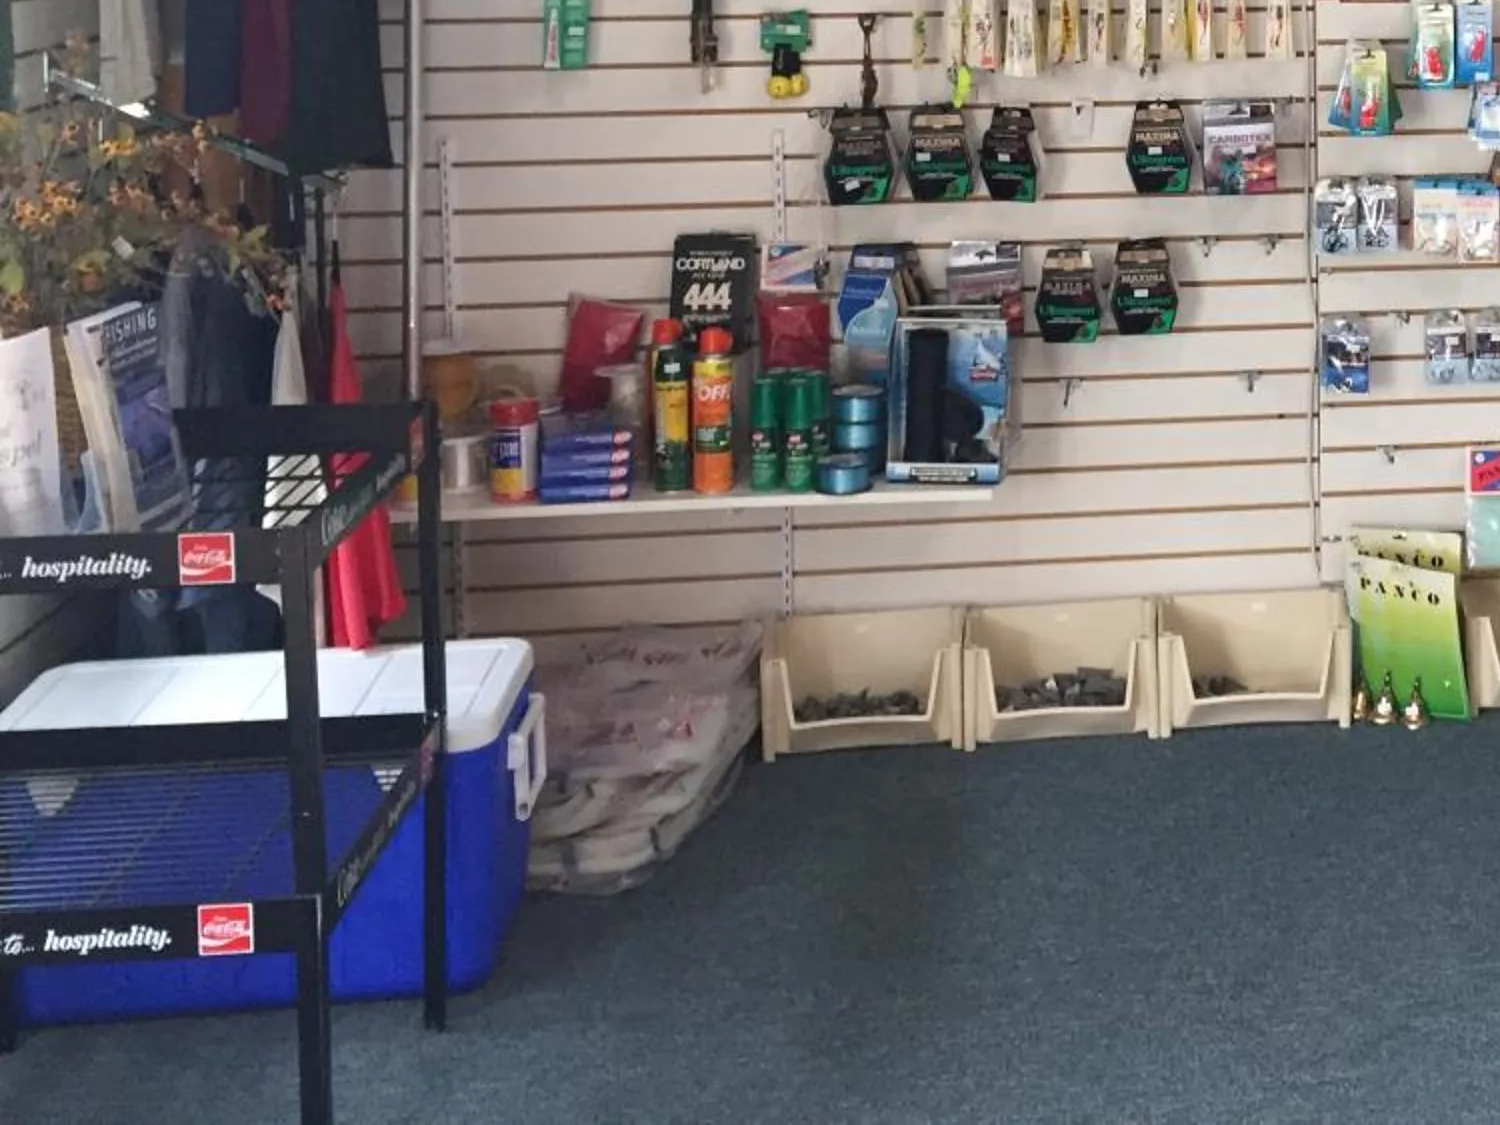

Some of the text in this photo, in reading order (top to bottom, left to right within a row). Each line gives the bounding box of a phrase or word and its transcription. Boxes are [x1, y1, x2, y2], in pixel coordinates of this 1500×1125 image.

[683, 281, 733, 311] 444
[21, 551, 153, 583] hospitality.
[43, 924, 173, 956] hospitality.
